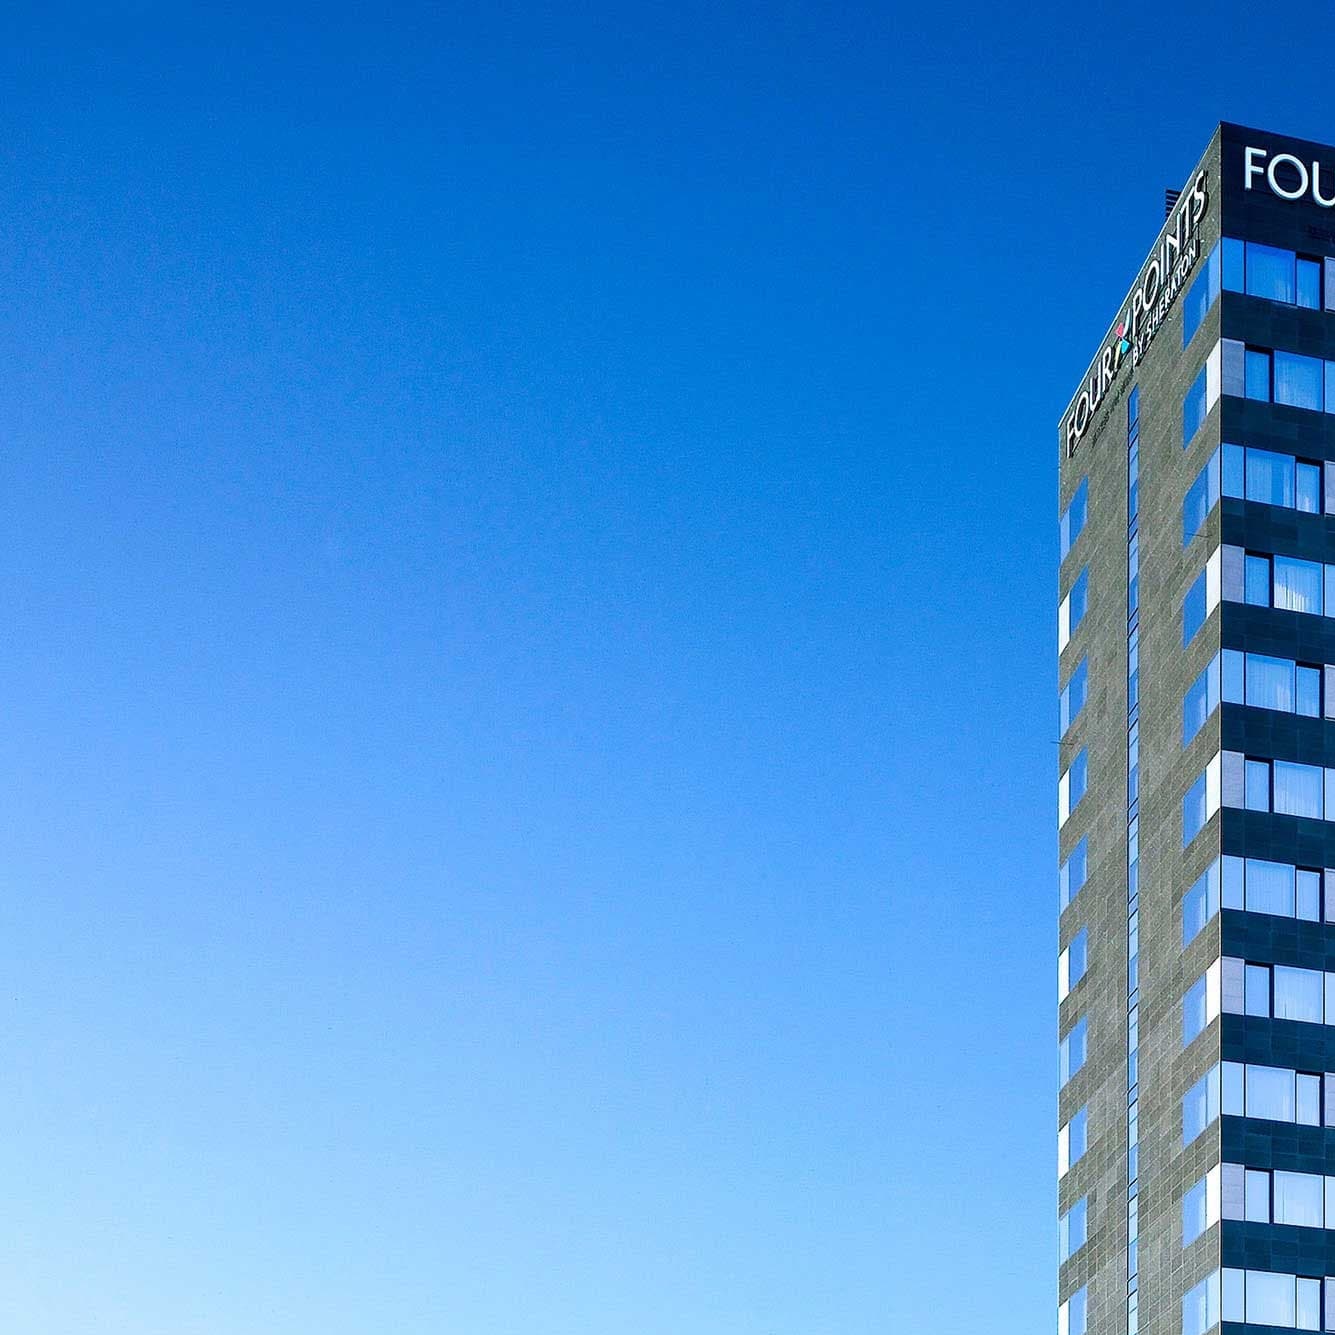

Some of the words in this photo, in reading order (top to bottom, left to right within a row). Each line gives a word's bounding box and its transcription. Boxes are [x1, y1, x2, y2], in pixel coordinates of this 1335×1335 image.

[1067, 346, 1114, 458] FOUR
[1131, 170, 1210, 334] POINTS
[1133, 336, 1145, 364] BY
[1146, 241, 1200, 346] SHERATON
